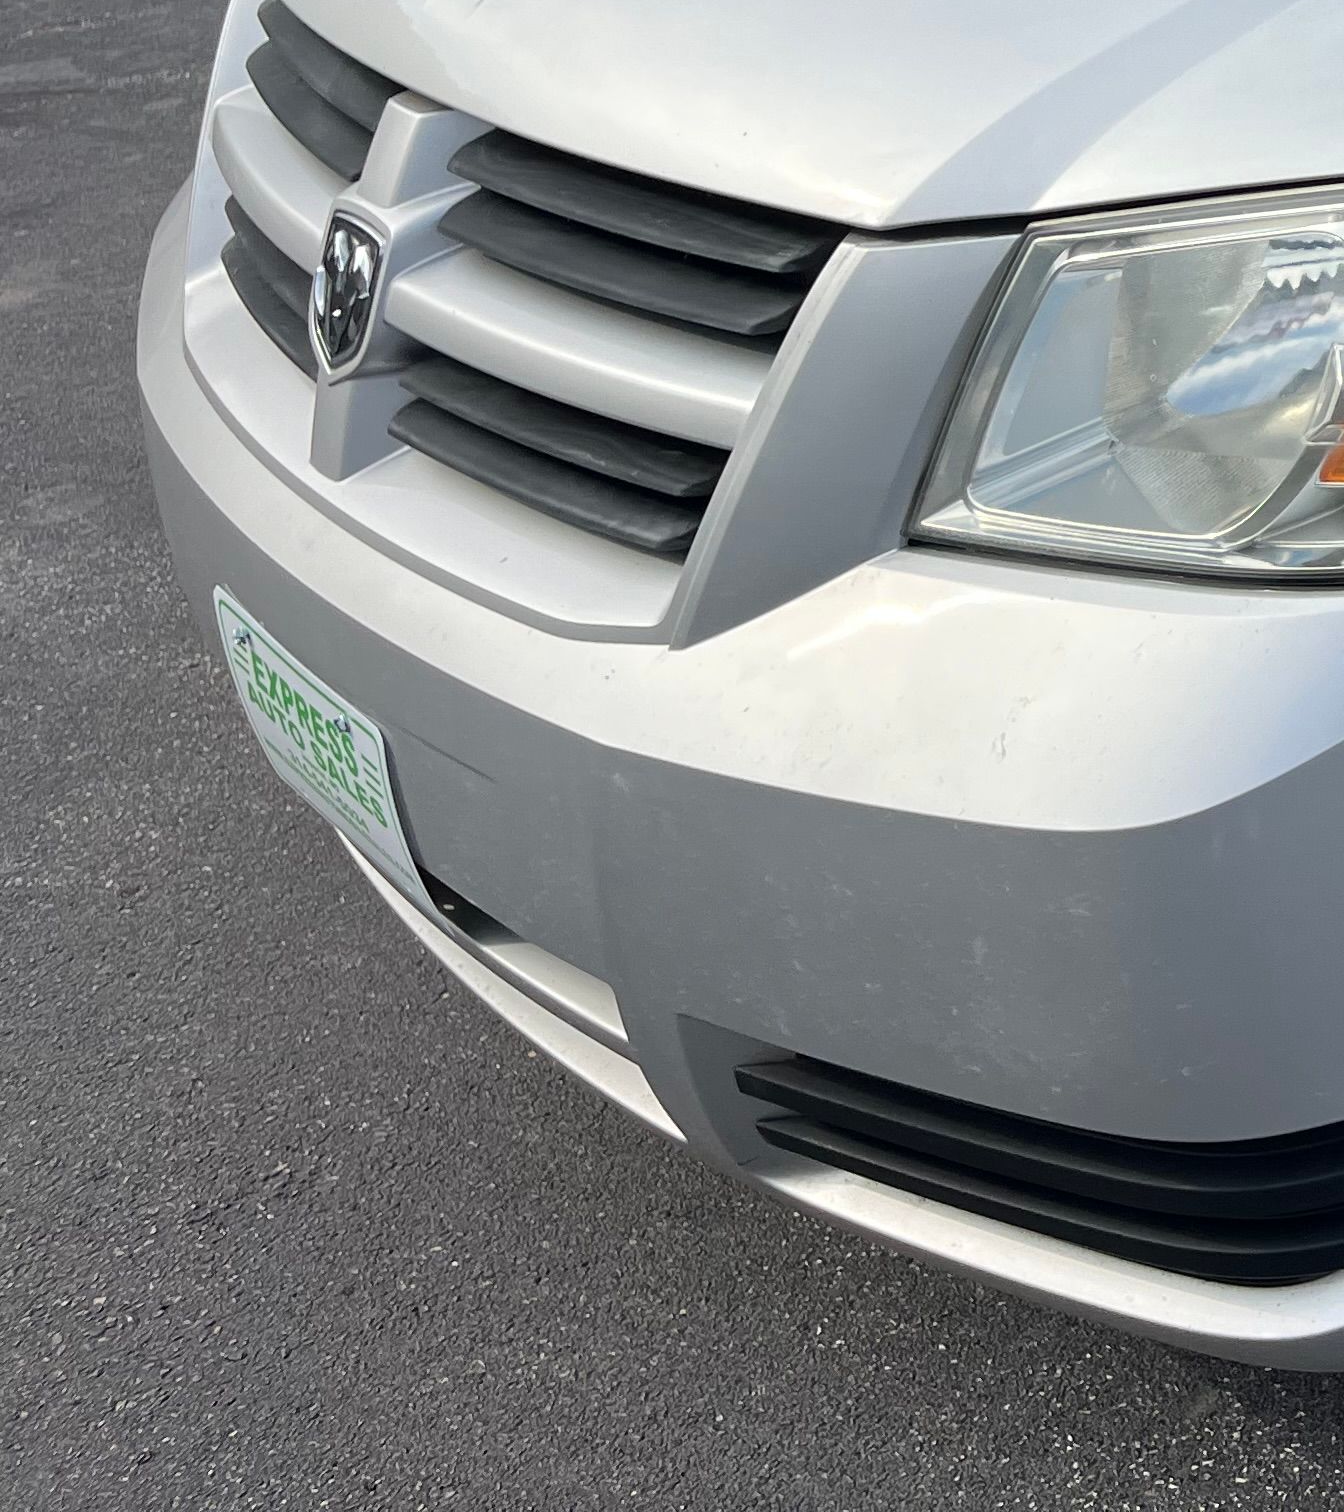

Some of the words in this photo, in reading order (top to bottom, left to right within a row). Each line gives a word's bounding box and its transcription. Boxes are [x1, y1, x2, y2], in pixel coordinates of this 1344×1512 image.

[246, 679, 306, 751] AUTO
[309, 740, 389, 829] SALES
[251, 650, 359, 778] EXPRESS
